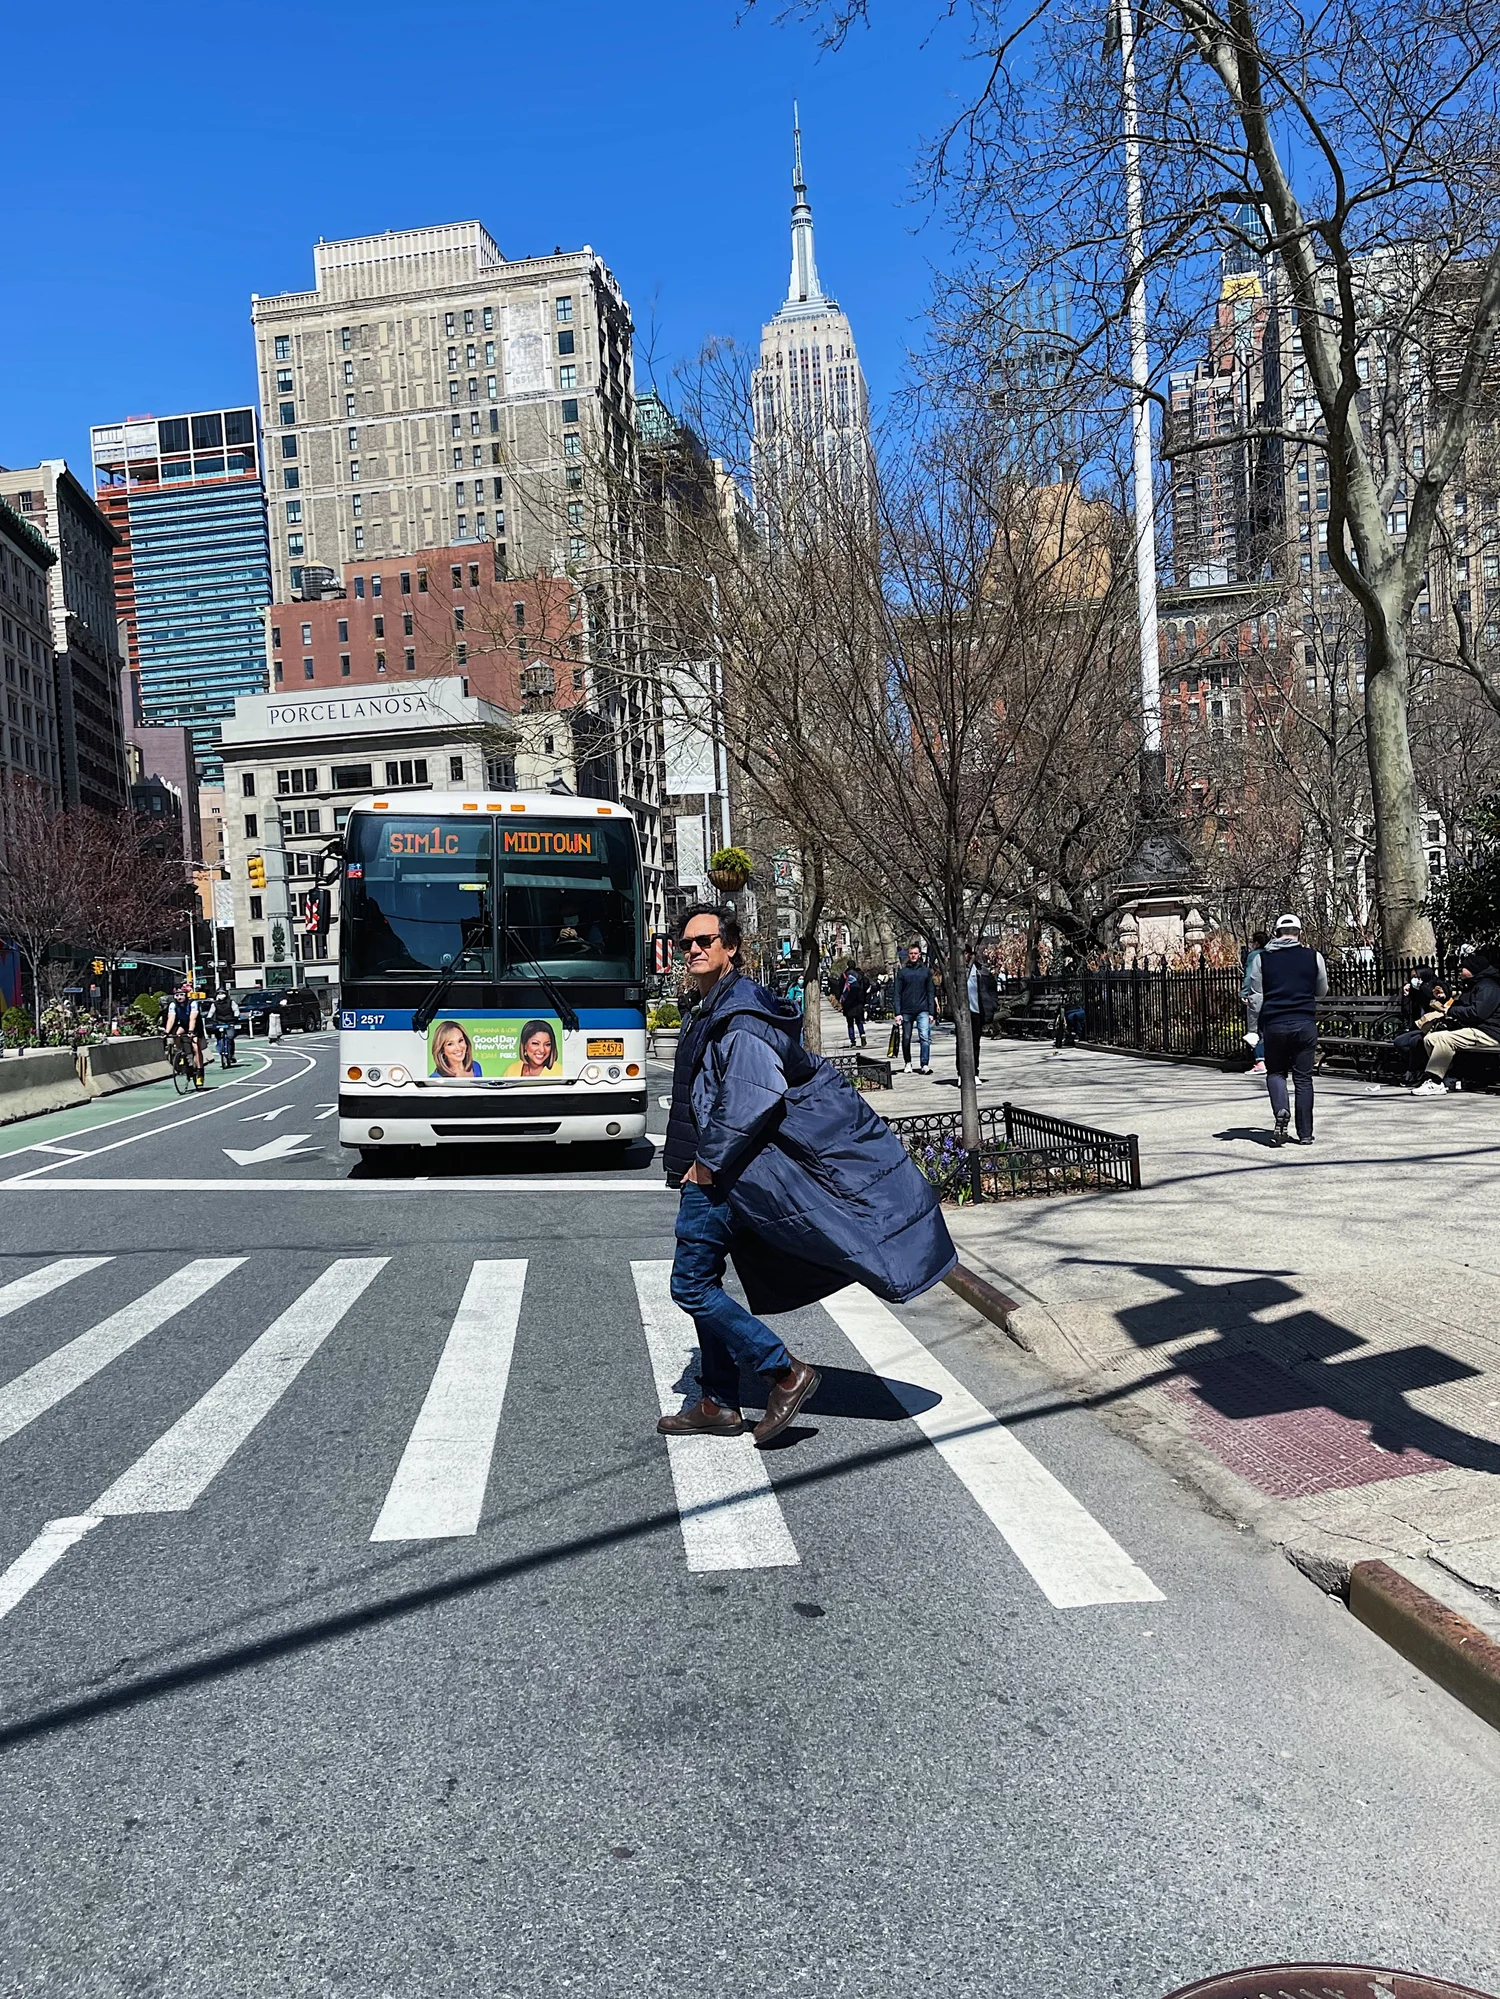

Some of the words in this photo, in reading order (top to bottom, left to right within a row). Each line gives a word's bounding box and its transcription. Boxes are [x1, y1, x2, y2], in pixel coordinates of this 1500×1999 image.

[271, 697, 427, 724] PORCELANOSA
[390, 827, 458, 853] SIM1C
[504, 832, 591, 854] MIDTOWN
[361, 1015, 385, 1024] 2517
[472, 1035, 499, 1043] Good
[499, 1035, 518, 1045] Day
